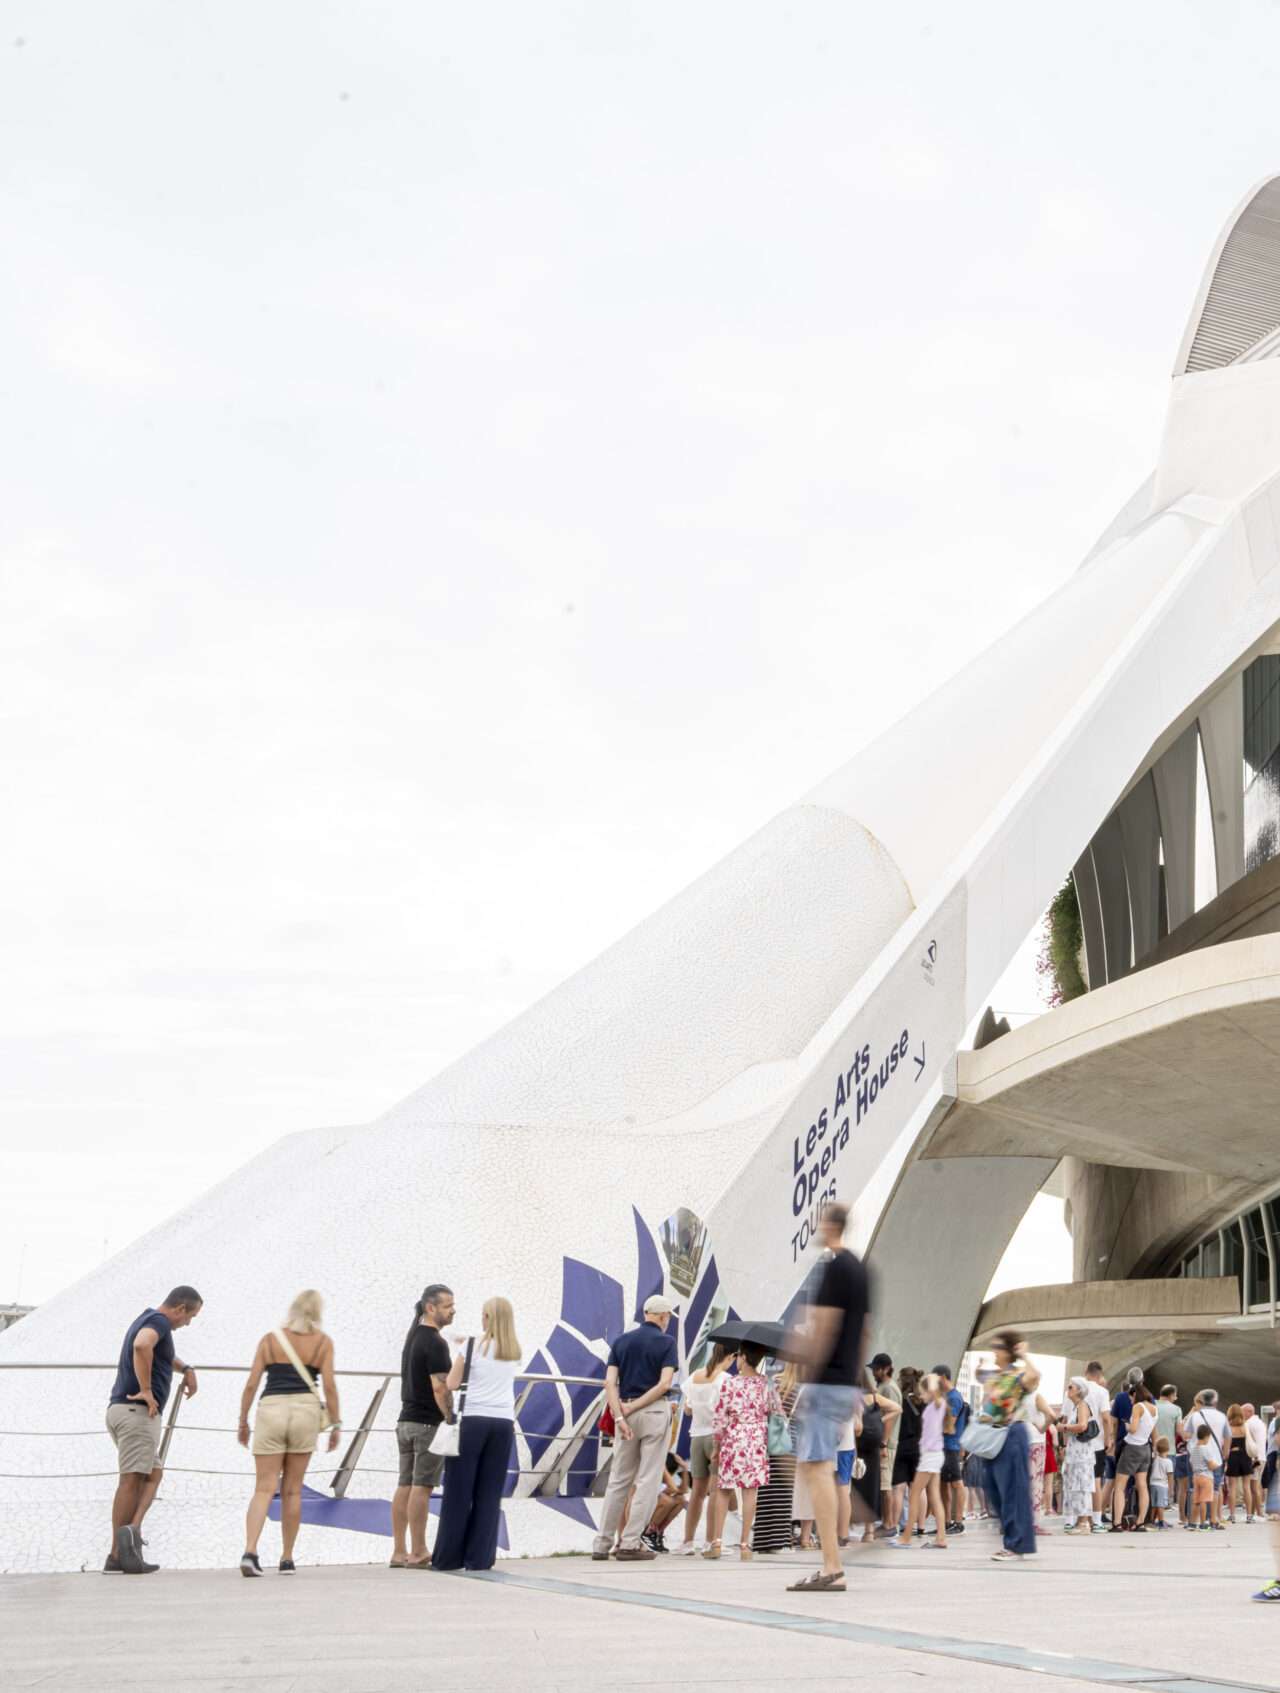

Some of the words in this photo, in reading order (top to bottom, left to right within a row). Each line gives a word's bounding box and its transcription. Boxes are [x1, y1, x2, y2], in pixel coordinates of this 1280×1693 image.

[792, 1116, 850, 1217] Opera
[856, 1029, 909, 1126] House
[793, 1107, 828, 1177] Les
[834, 1043, 870, 1118] Arts
